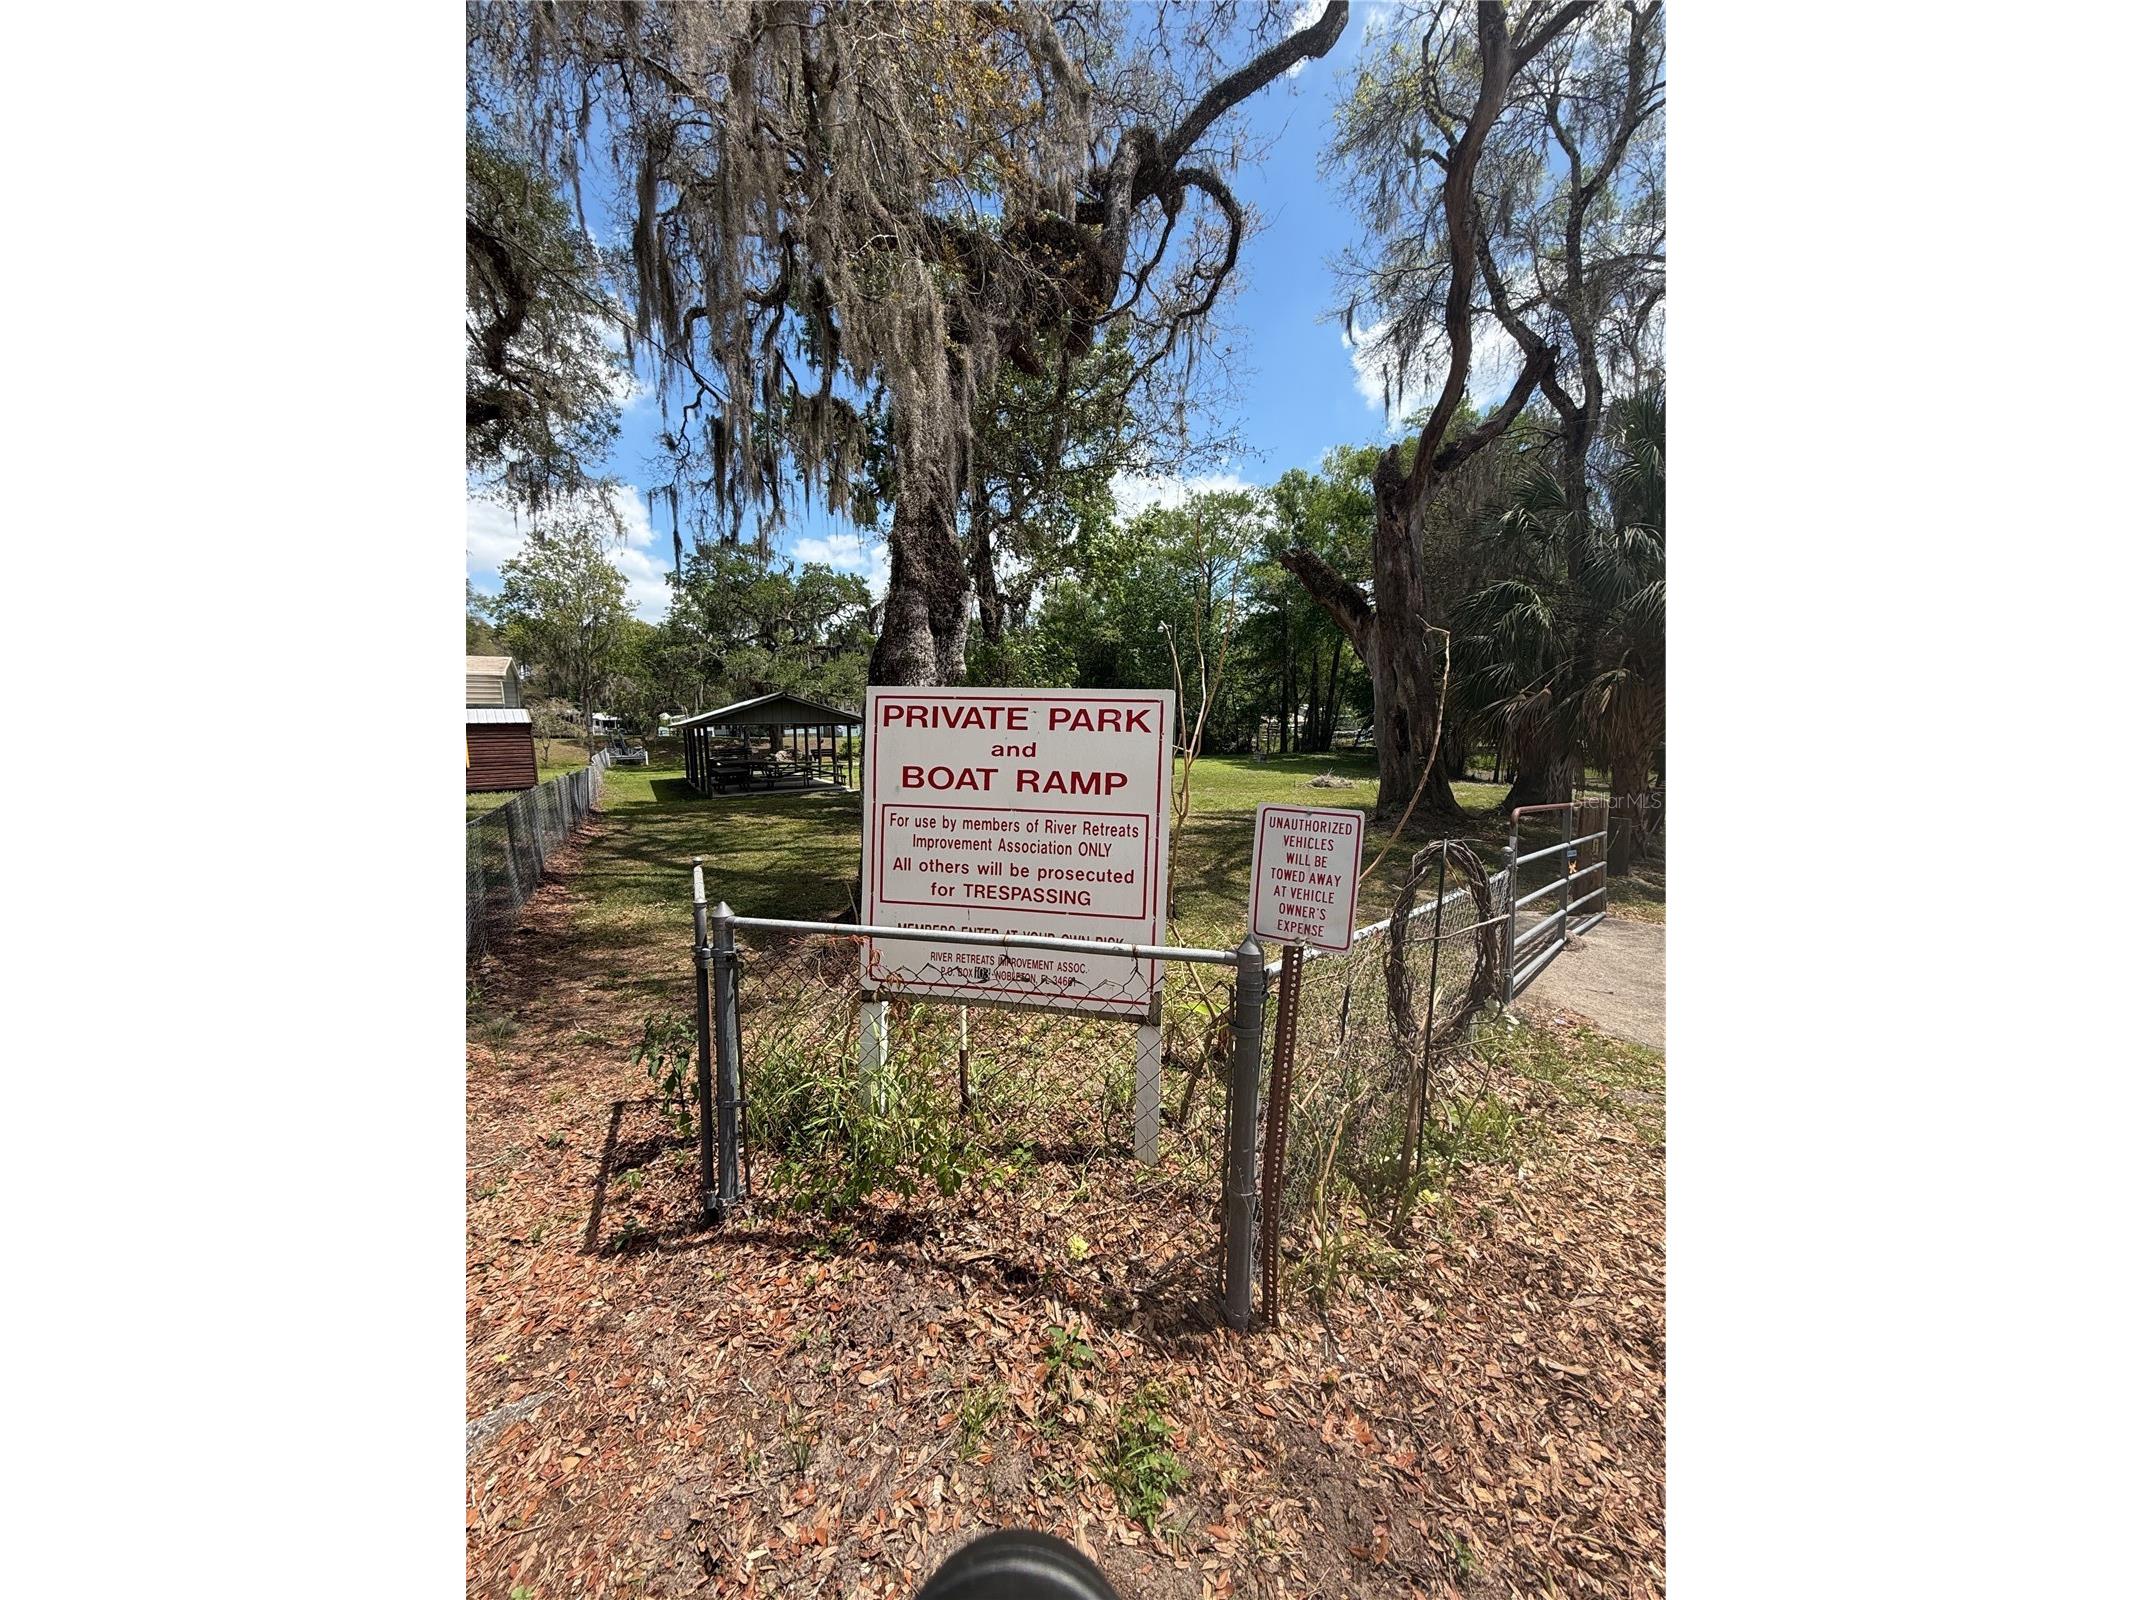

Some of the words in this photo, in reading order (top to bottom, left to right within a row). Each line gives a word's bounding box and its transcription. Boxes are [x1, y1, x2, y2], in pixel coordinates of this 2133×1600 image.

[883, 705, 1029, 731] PRIVATE
[1048, 707, 1152, 733] PARK
[991, 742, 1036, 758] and
[902, 765, 998, 791] BOAT
[1016, 769, 1128, 796] RAMP
[889, 812, 910, 827] For
[914, 817, 937, 829] use
[942, 815, 957, 832] by
[962, 818, 1020, 833] members
[1026, 819, 1040, 834] of
[1044, 819, 1077, 835] River
[1083, 821, 1139, 838] Retreats
[1269, 816, 1352, 835] UNAUTHORIZED
[912, 833, 992, 853] Improvement
[997, 837, 1072, 856] Association
[1078, 842, 1113, 858] ONLY
[1283, 835, 1334, 852] VEHICLES
[1286, 852, 1310, 867] WILL
[1314, 856, 1328, 868] BE
[892, 857, 911, 871] All
[919, 860, 969, 875] others
[977, 861, 1002, 877] will
[1010, 863, 1030, 878] be
[1037, 867, 1135, 884] prosecuted
[1270, 867, 1305, 883] TOWED
[1308, 871, 1342, 888] AWAY
[930, 881, 954, 897] for
[963, 883, 1092, 906] TRESPASSING
[1273, 885, 1287, 898] AT
[1290, 887, 1335, 904] VEHICLE
[1278, 902, 1326, 921] OWNER'S
[1277, 919, 1325, 938] EXPENSE
[930, 951, 953, 962] RIVER
[955, 953, 995, 965] RETREATS
[998, 956, 1054, 971] IMPROVEMENT
[1057, 961, 1088, 974] ASSOC.
[957, 968, 973, 978] BOX
